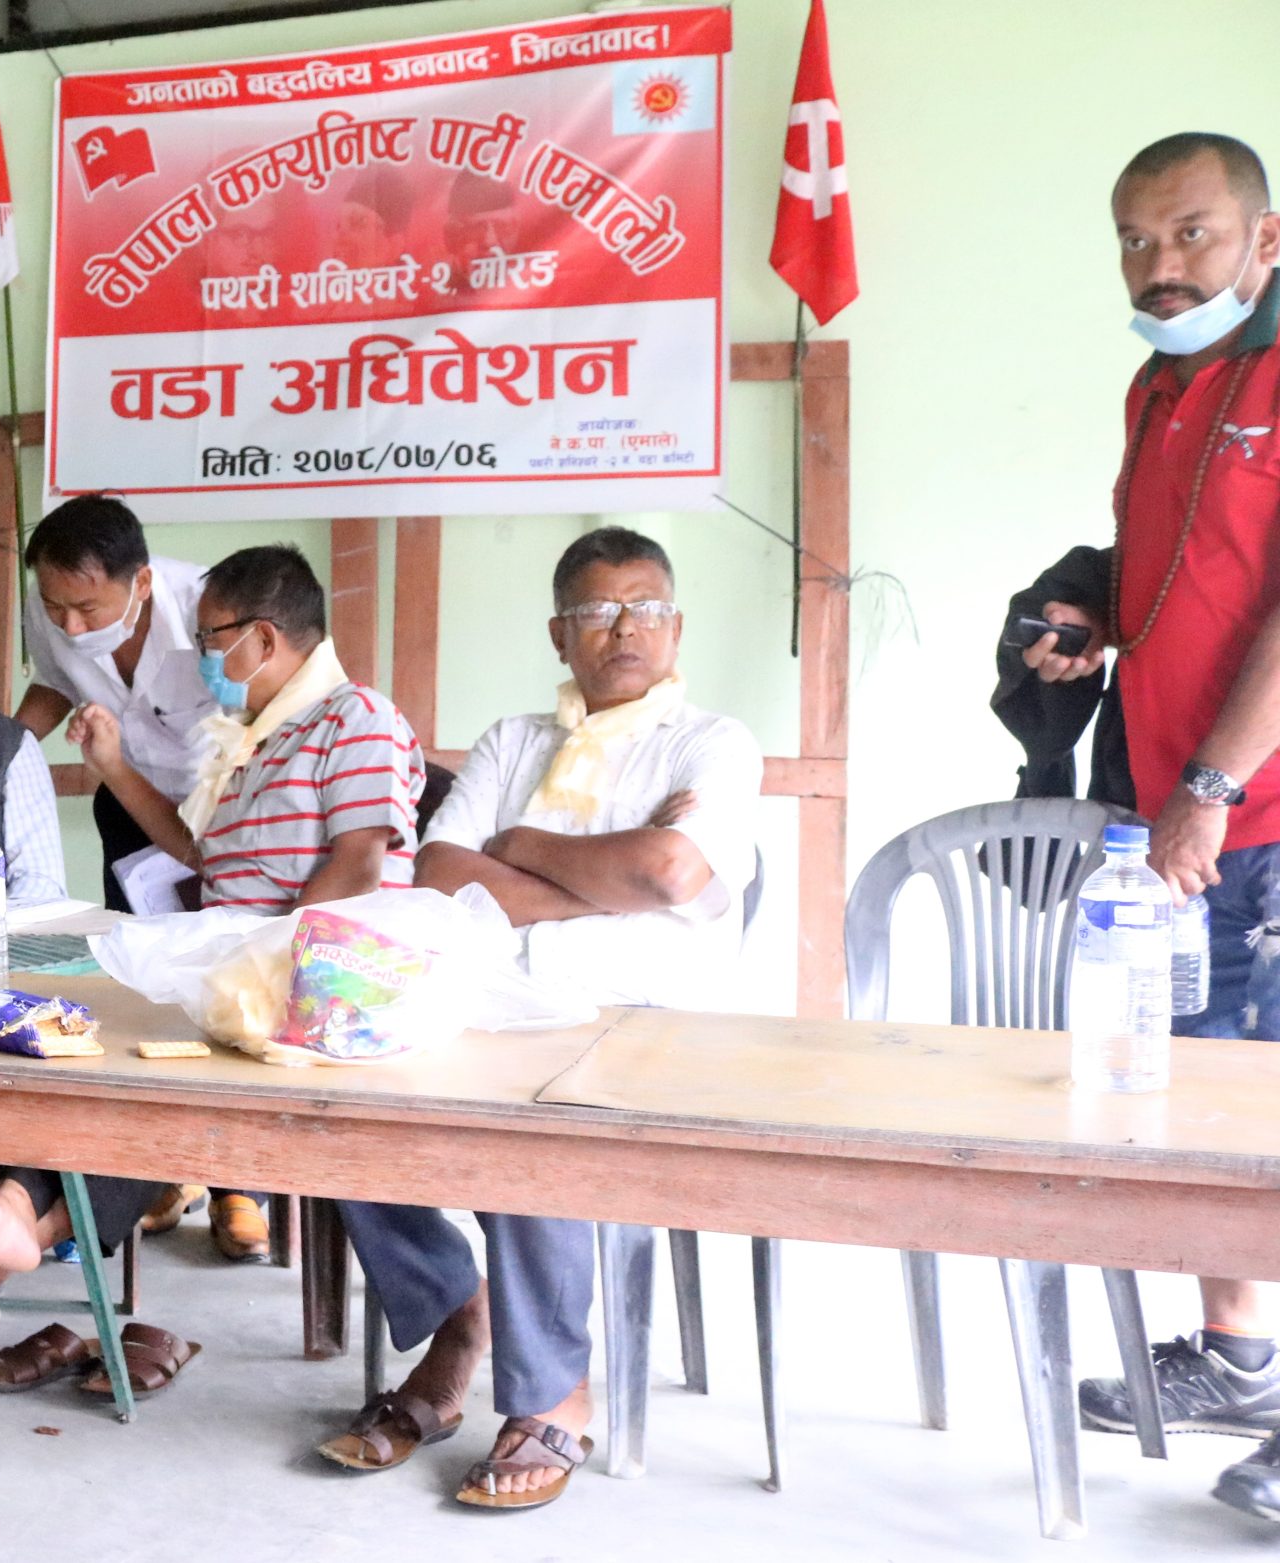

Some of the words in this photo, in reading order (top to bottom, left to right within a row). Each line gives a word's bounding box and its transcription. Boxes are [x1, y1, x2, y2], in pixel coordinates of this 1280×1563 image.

[126, 68, 239, 107] जनताको
[246, 60, 373, 100] बहुदलिय
[83, 184, 217, 308] नेपाल
[209, 109, 419, 198] कम्युनिष्ट
[427, 109, 528, 182] पार्टी
[200, 264, 282, 311] पथरी
[469, 246, 560, 290] मोरङ
[109, 362, 244, 421] वडा
[269, 327, 638, 416] अधिवेशन
[293, 440, 498, 474] २०७८/०७/०६
